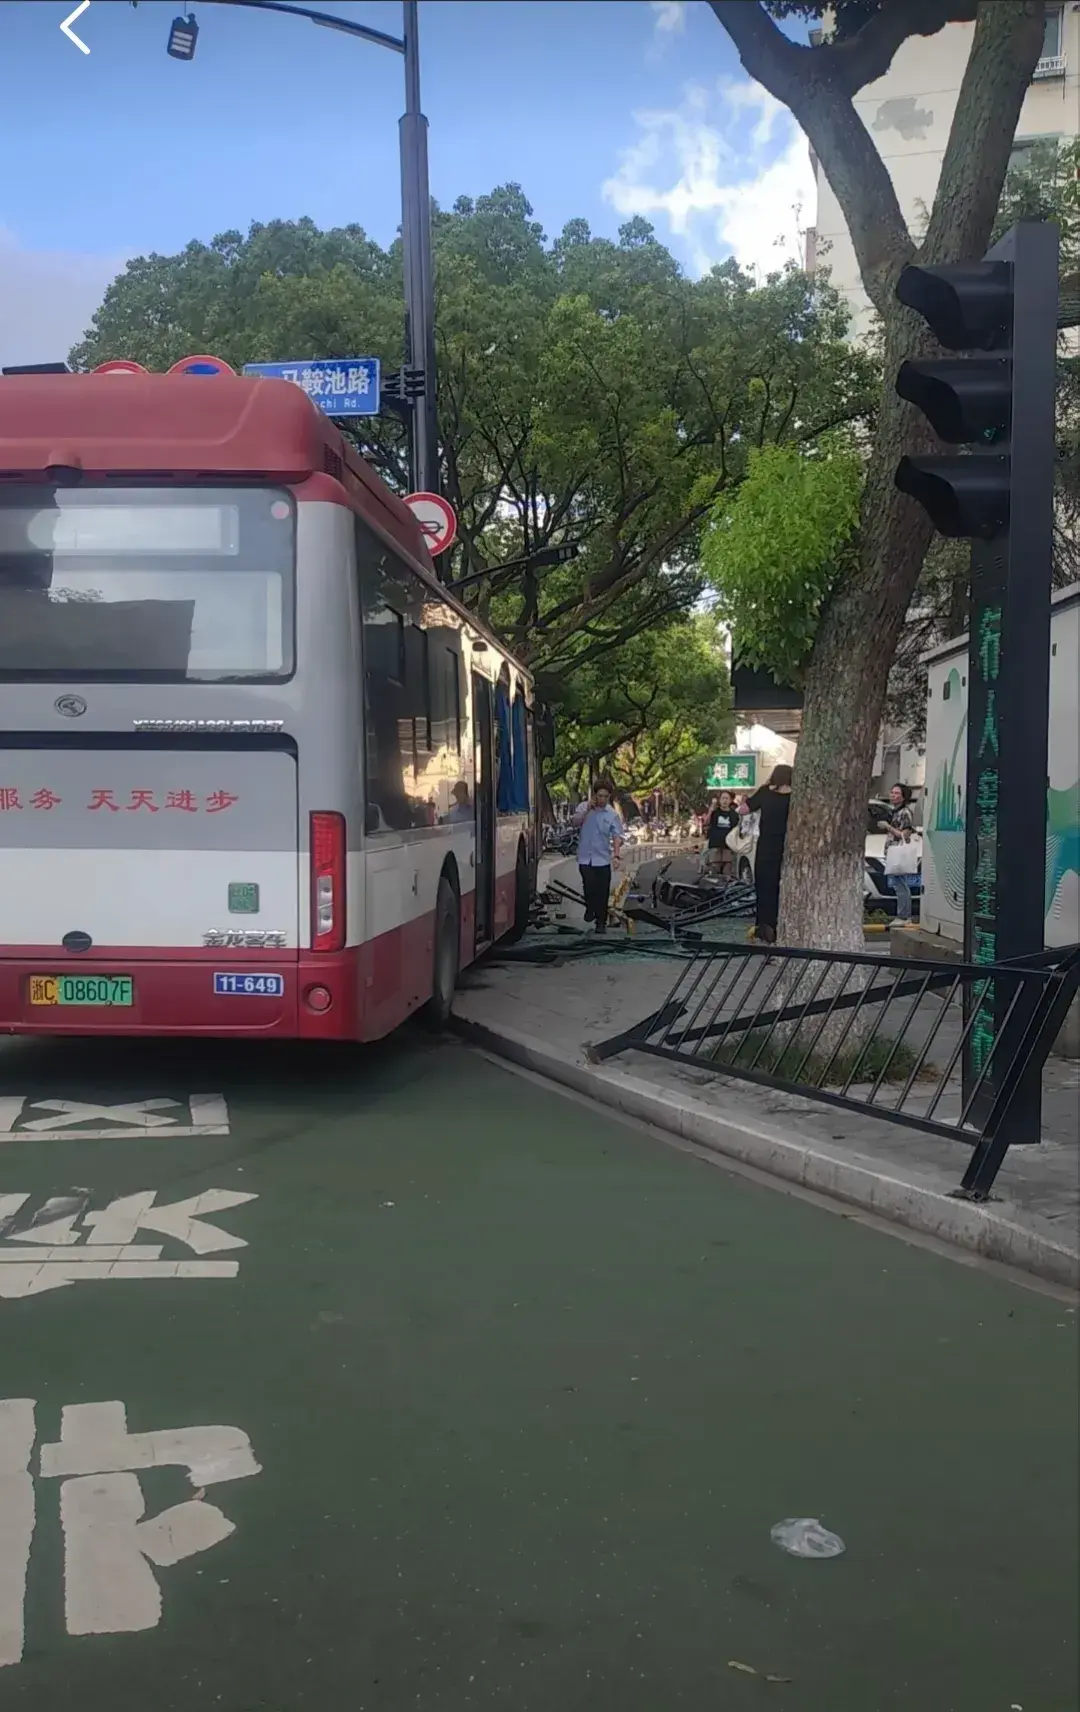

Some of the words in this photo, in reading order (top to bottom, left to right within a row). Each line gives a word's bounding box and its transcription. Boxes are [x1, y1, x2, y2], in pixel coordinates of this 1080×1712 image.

[0, 787, 62, 811] 服务
[87, 789, 239, 813] 天天进步
[219, 976, 278, 993] 11-649
